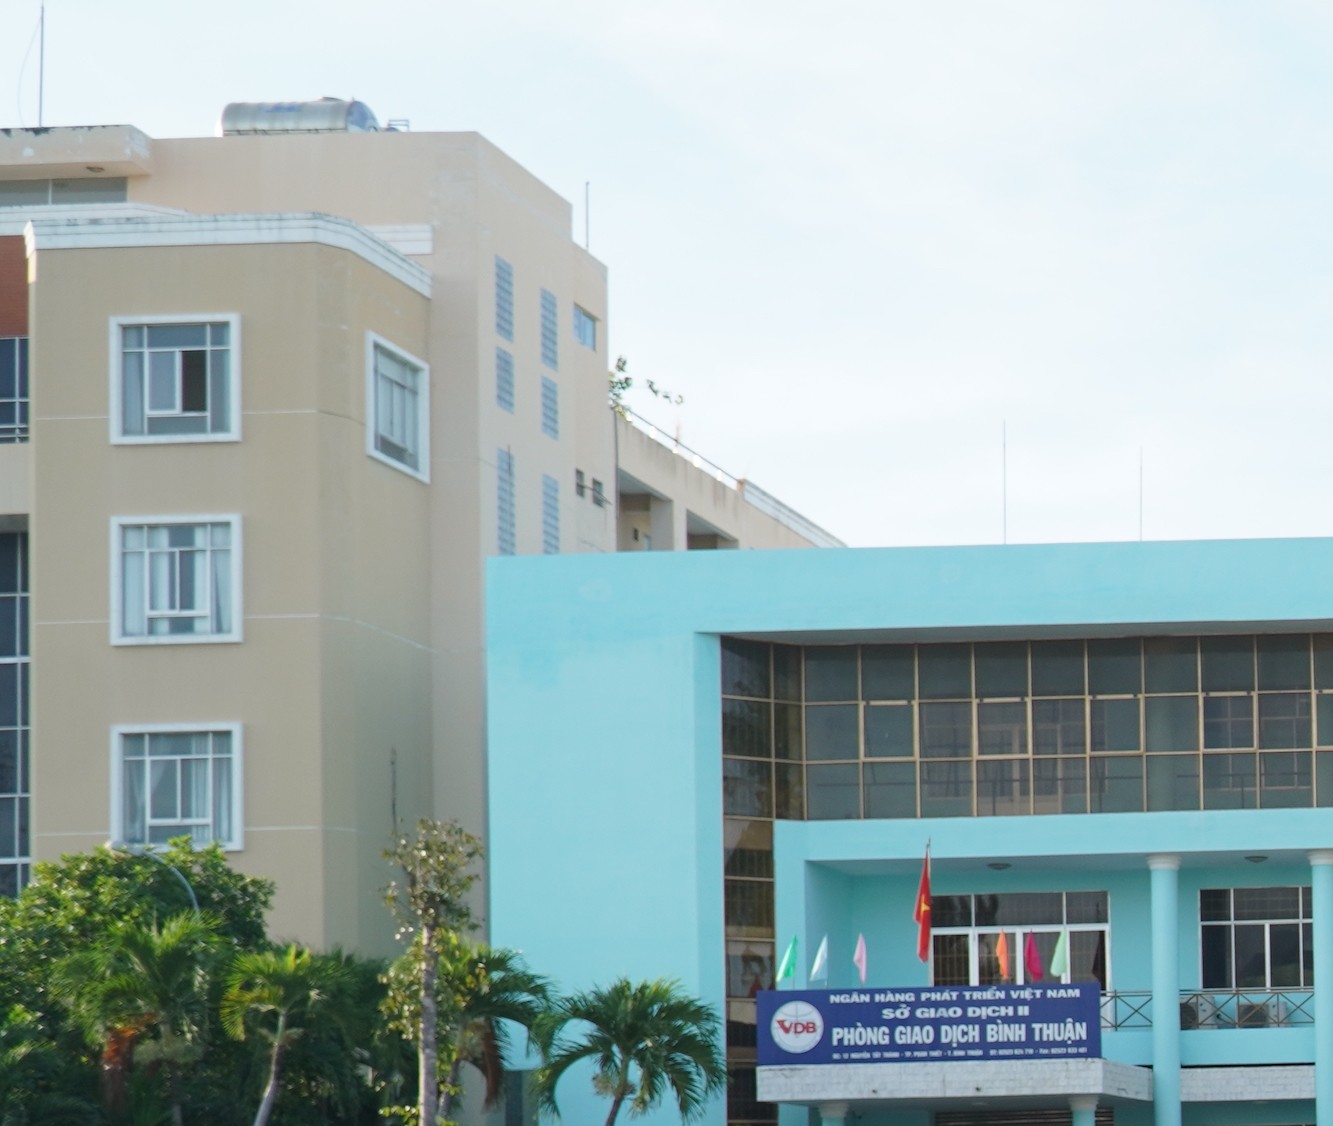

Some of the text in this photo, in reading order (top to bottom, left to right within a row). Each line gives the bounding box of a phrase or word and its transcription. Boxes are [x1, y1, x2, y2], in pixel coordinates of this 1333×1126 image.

[830, 986, 1080, 1004] NGÂN HÀNG PHÁT TRIỂN VIỆT NAM
[882, 1004, 1029, 1019] SỞ GIAO DỊCH II
[776, 1020, 816, 1034] VDB
[832, 1018, 1087, 1047] PHÒNG GIAO DỊCH BÌNH THUẬN
